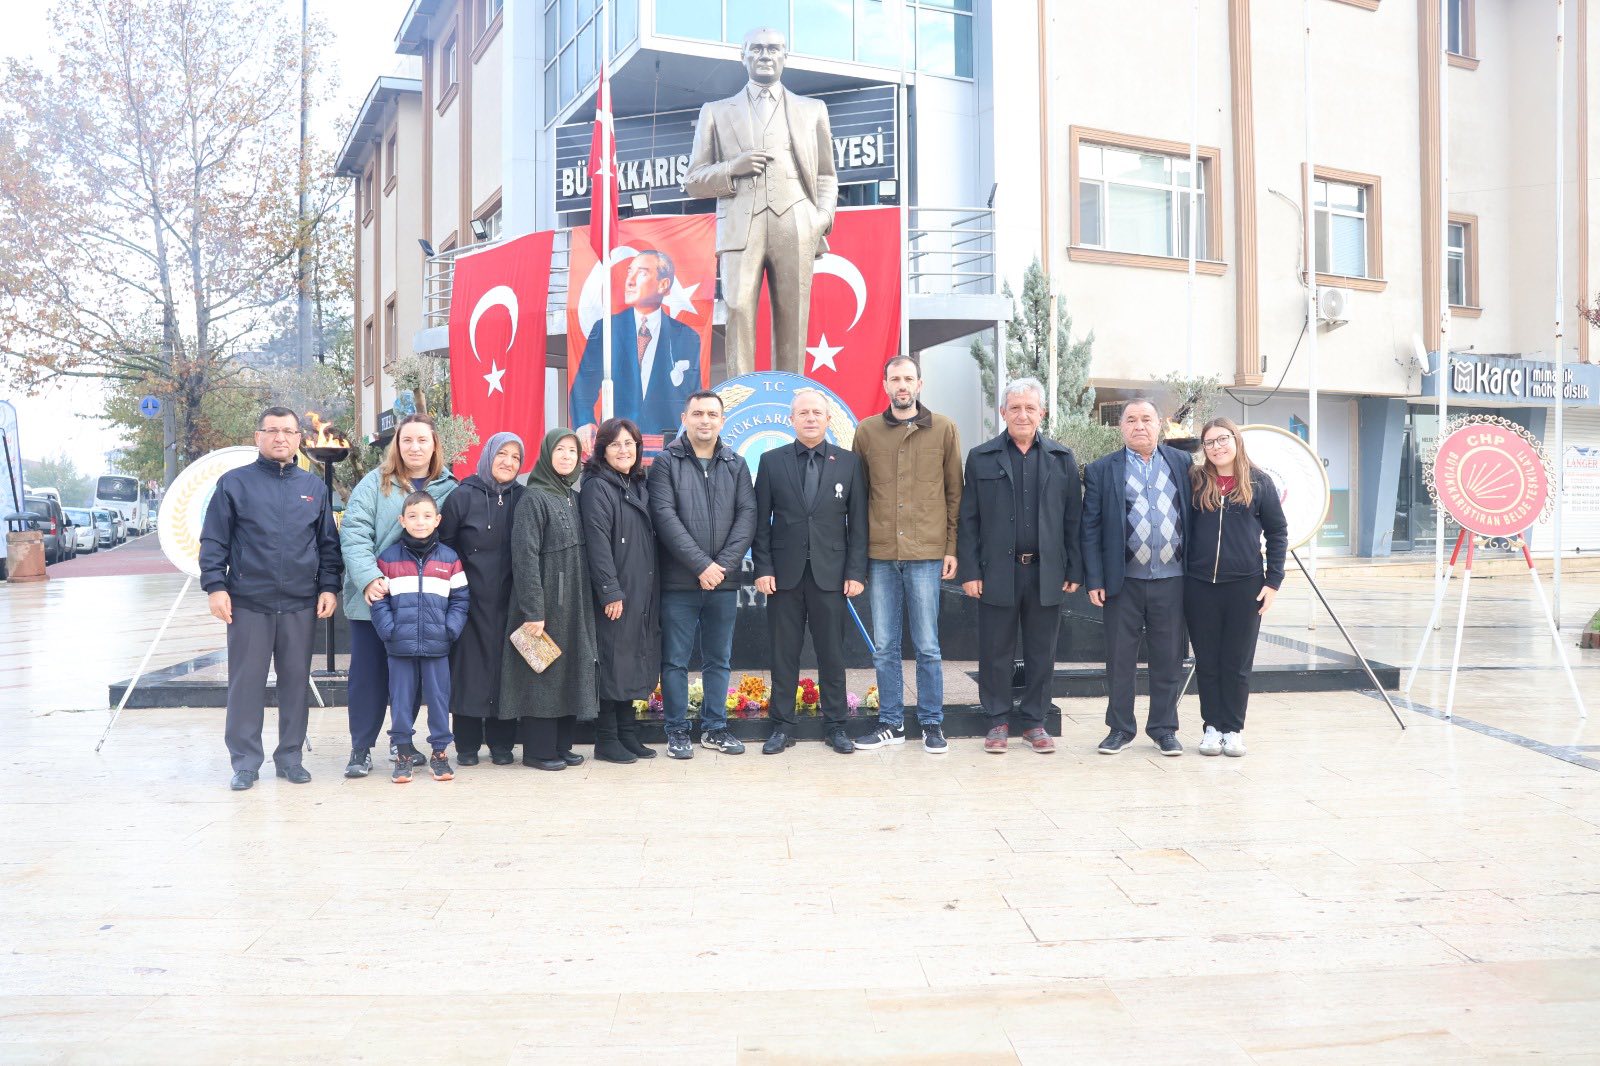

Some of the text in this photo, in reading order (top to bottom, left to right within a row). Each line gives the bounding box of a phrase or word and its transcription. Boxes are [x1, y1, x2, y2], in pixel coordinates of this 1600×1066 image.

[562, 126, 884, 197] BÜKKARIŞ YESİ
[1476, 362, 1522, 396] Kare
[1532, 368, 1574, 383] mimalık
[762, 381, 787, 392] T.C.
[1532, 382, 1590, 399] mühedislik
[722, 413, 793, 447] ÜYÜKKARIŞ
[1466, 433, 1505, 446] CHP
[1503, 501, 1532, 525] BELDE
